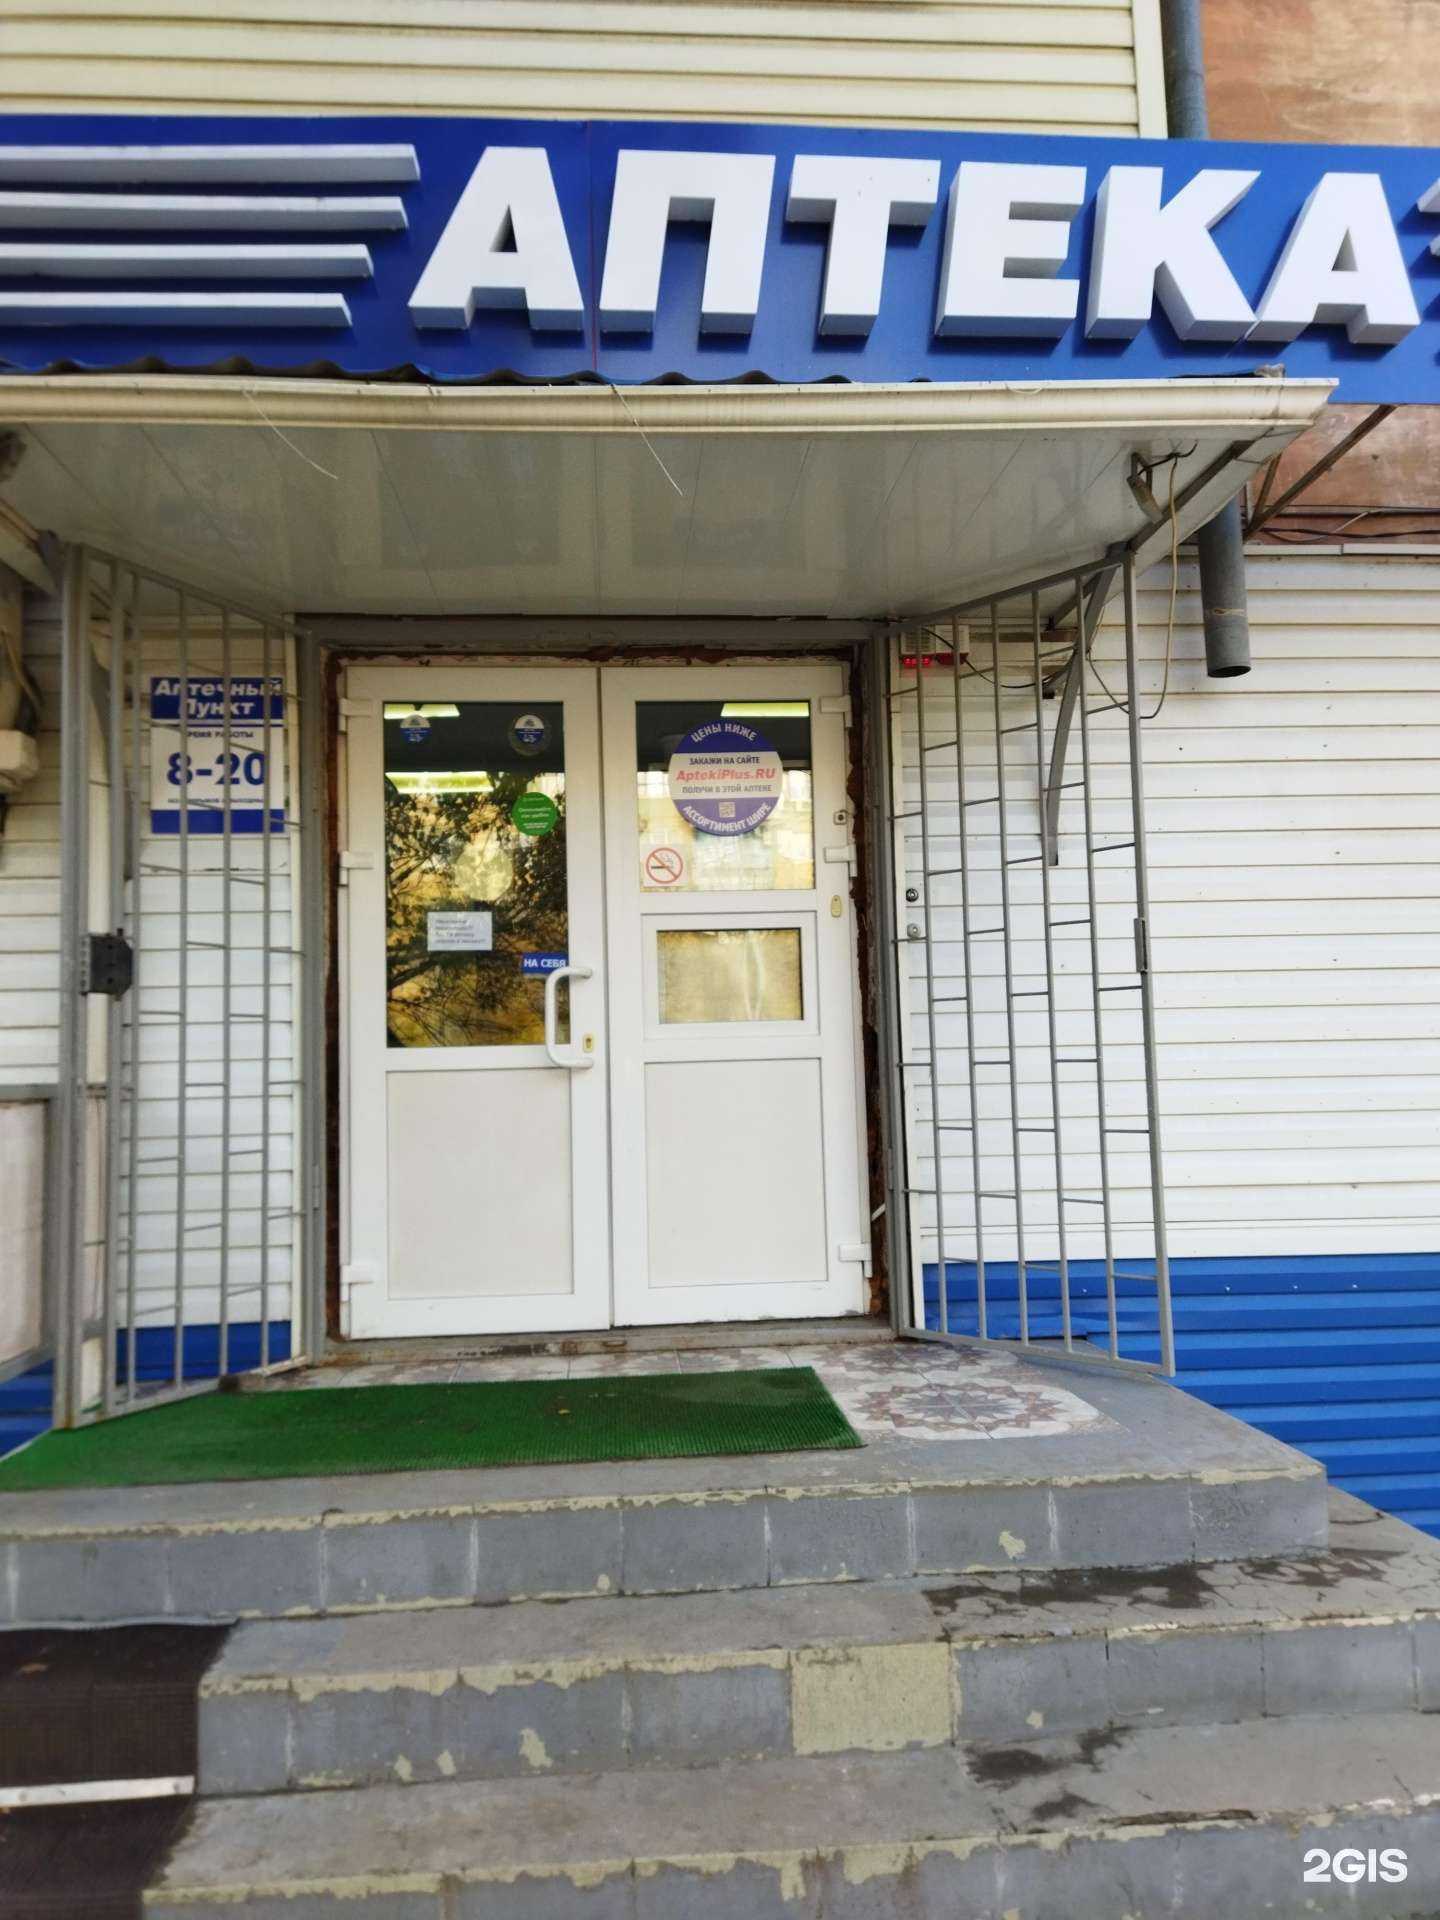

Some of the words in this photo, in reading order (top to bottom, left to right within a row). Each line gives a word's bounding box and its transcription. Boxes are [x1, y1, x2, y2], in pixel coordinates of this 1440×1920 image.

[407, 145, 1420, 344] АПТЕКА
[691, 723, 722, 743] ЦЕНЫ
[725, 723, 758, 741] НИЖЕ
[167, 752, 269, 786] 8-20
[689, 756, 722, 766] ЗАКАЖИ
[723, 756, 735, 765] НА
[736, 754, 761, 765] САЙТЕ
[682, 805, 746, 833] АССОРТИМЕНТ
[746, 802, 772, 826] ШИРЕ
[523, 958, 539, 968] НА
[541, 958, 567, 968] СЕБЯ
